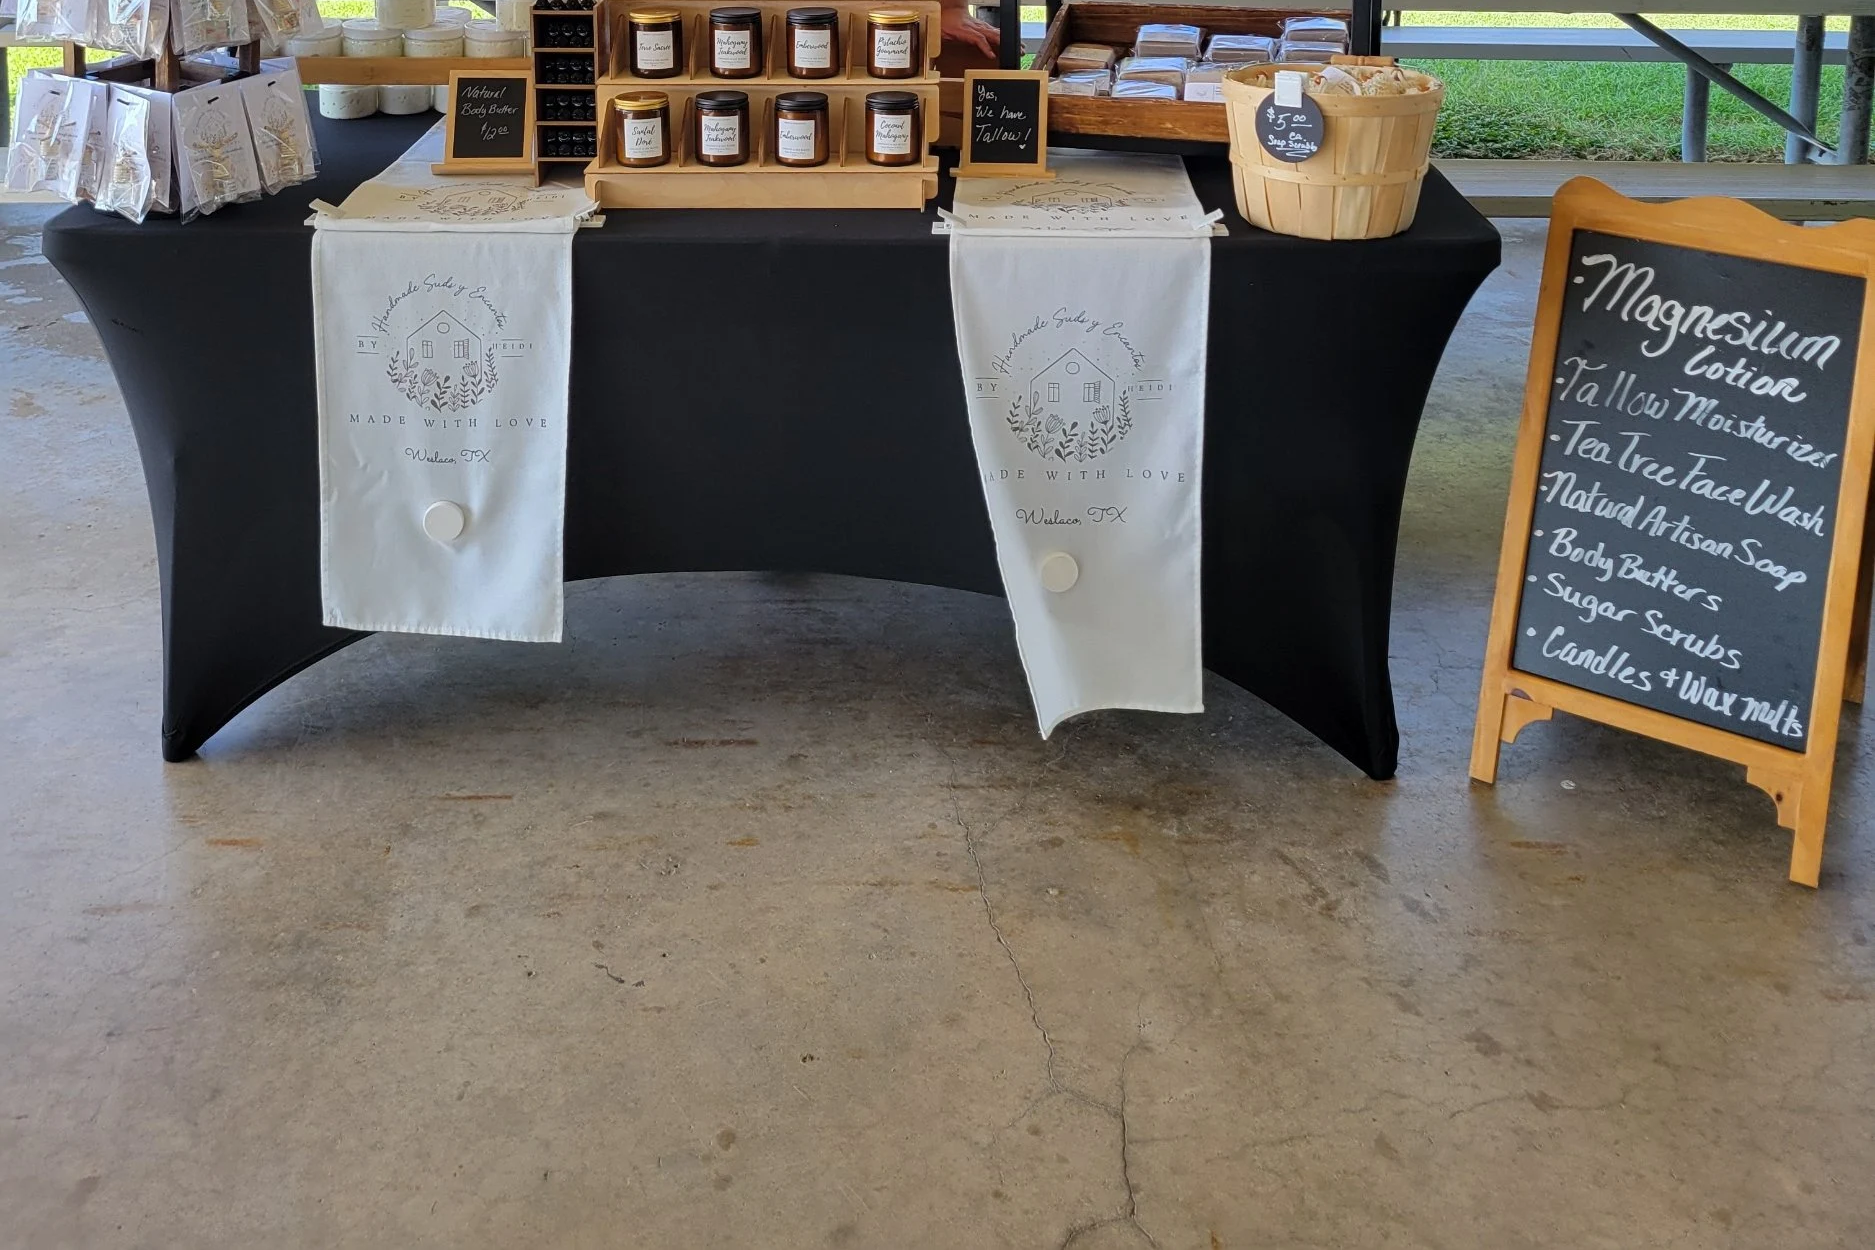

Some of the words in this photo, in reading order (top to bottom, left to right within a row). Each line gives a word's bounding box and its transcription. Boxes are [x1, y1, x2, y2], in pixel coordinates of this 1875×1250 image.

[716, 36, 748, 50] Mahogany
[796, 40, 829, 50] Emberwood
[877, 35, 907, 46] Pistachio
[876, 46, 908, 57] Gourmand
[462, 86, 506, 98] Natural
[977, 84, 998, 101] Yes,
[461, 102, 486, 118] Body
[488, 104, 519, 114] Butter
[976, 106, 994, 118] We
[1000, 106, 1026, 120] have
[632, 124, 656, 136] Santal
[704, 122, 736, 136] Mahogany
[880, 120, 905, 130] Coconut
[705, 132, 736, 142] Teakwood
[876, 128, 908, 142] Mahogany
[1268, 134, 1286, 148] Soap
[371, 280, 420, 336] Handmade
[423, 274, 456, 292] Suds
[453, 284, 468, 296] y
[1582, 253, 1842, 371] Magnesium
[358, 340, 378, 349] BY
[992, 316, 1048, 375] Handmade
[1052, 306, 1089, 328] Suds
[1086, 318, 1101, 333] y
[1102, 321, 1147, 372] Encantos
[1684, 345, 1807, 403] Lotion
[976, 383, 998, 392] BY
[1127, 384, 1172, 392] HEIDI
[1563, 356, 1670, 420] Tallow
[350, 413, 406, 425] MADE
[424, 418, 478, 428] WITH
[494, 418, 548, 428] LOVE
[460, 449, 492, 464] TX
[1046, 470, 1106, 481] WITH
[1126, 468, 1186, 483] LOVE
[1561, 419, 1613, 465] Tea
[1618, 431, 1677, 487] Tree
[1679, 452, 1746, 508] Face
[1749, 479, 1825, 537] Wash
[1016, 508, 1082, 526] Weslaco,
[1087, 506, 1128, 524] TX
[1543, 470, 1645, 529] Natural
[1638, 505, 1734, 560] Artisan
[1734, 538, 1808, 592] Soap
[1548, 527, 1614, 582] Body
[1617, 553, 1723, 612] Butters
[1543, 572, 1639, 623] Sugar
[1640, 609, 1743, 670] Scrubs
[1542, 625, 1653, 692] Candles
[1677, 670, 1739, 717] Wax
